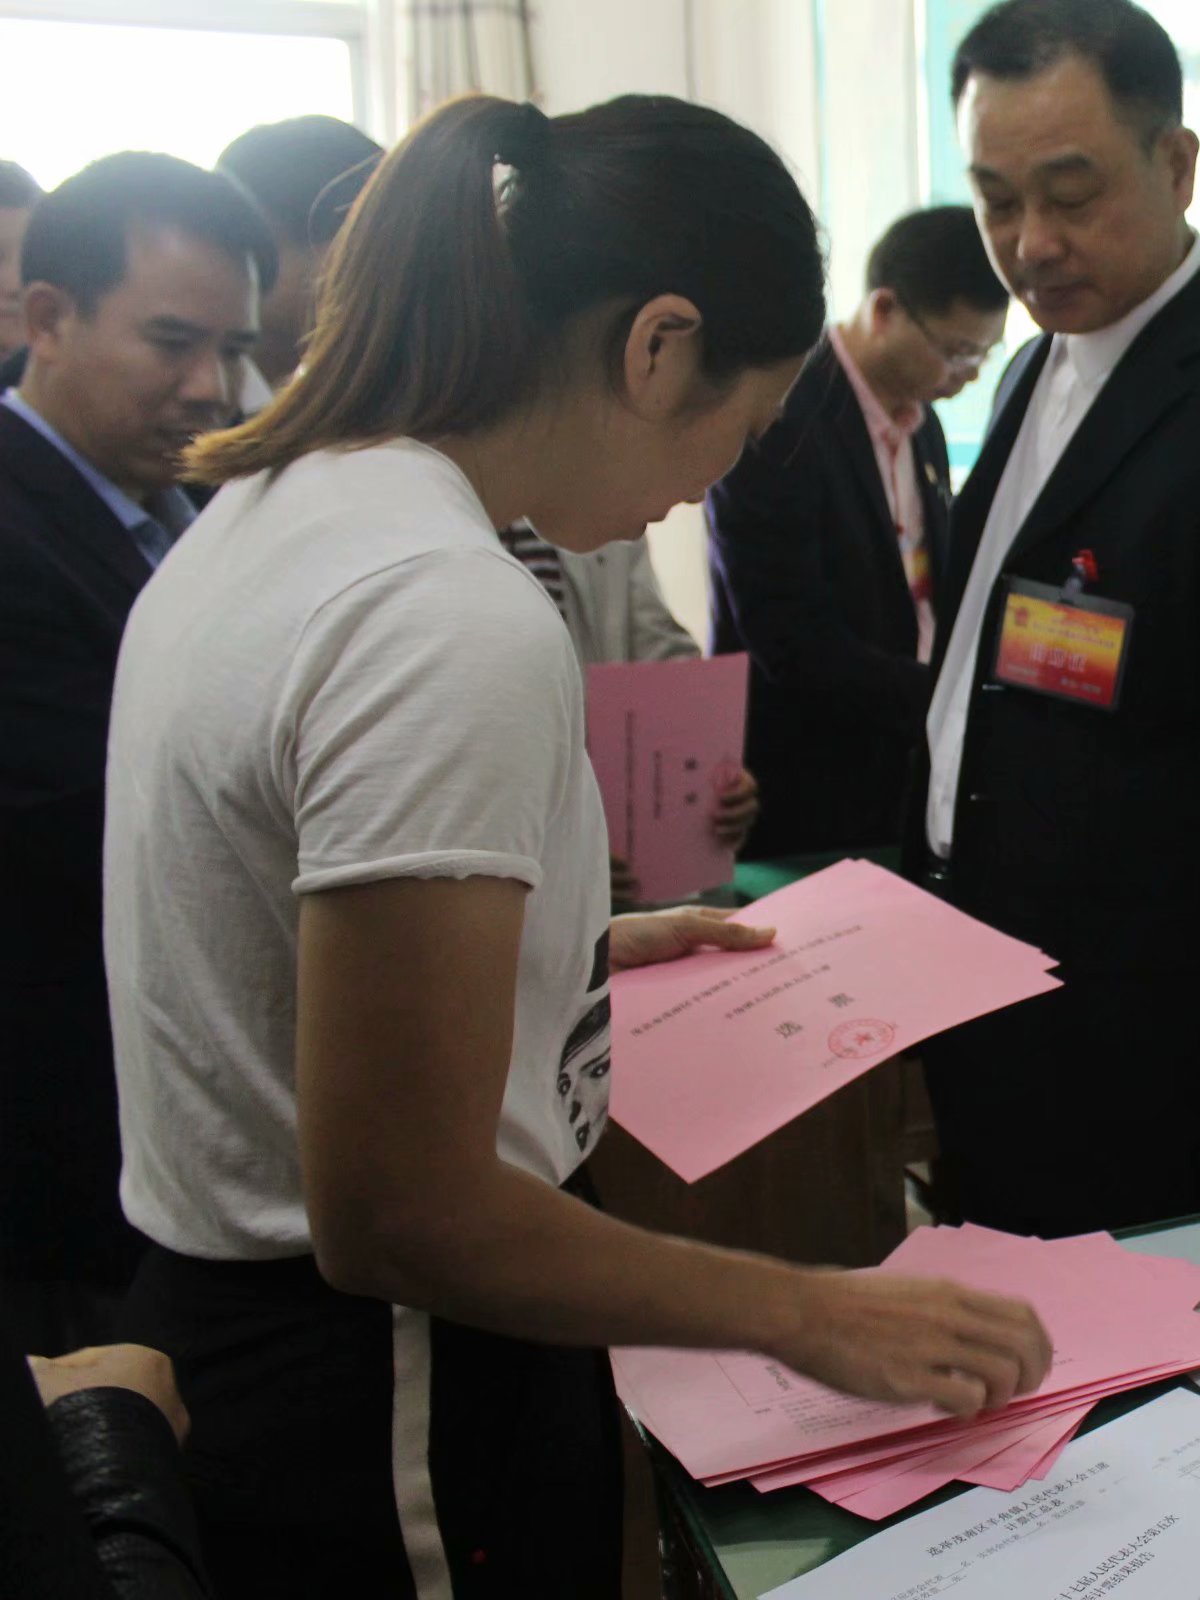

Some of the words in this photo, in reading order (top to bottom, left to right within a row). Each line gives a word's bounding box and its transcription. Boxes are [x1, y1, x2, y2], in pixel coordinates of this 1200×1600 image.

[1055, 1514, 1180, 1600] 十七届人民代表大会第五次
